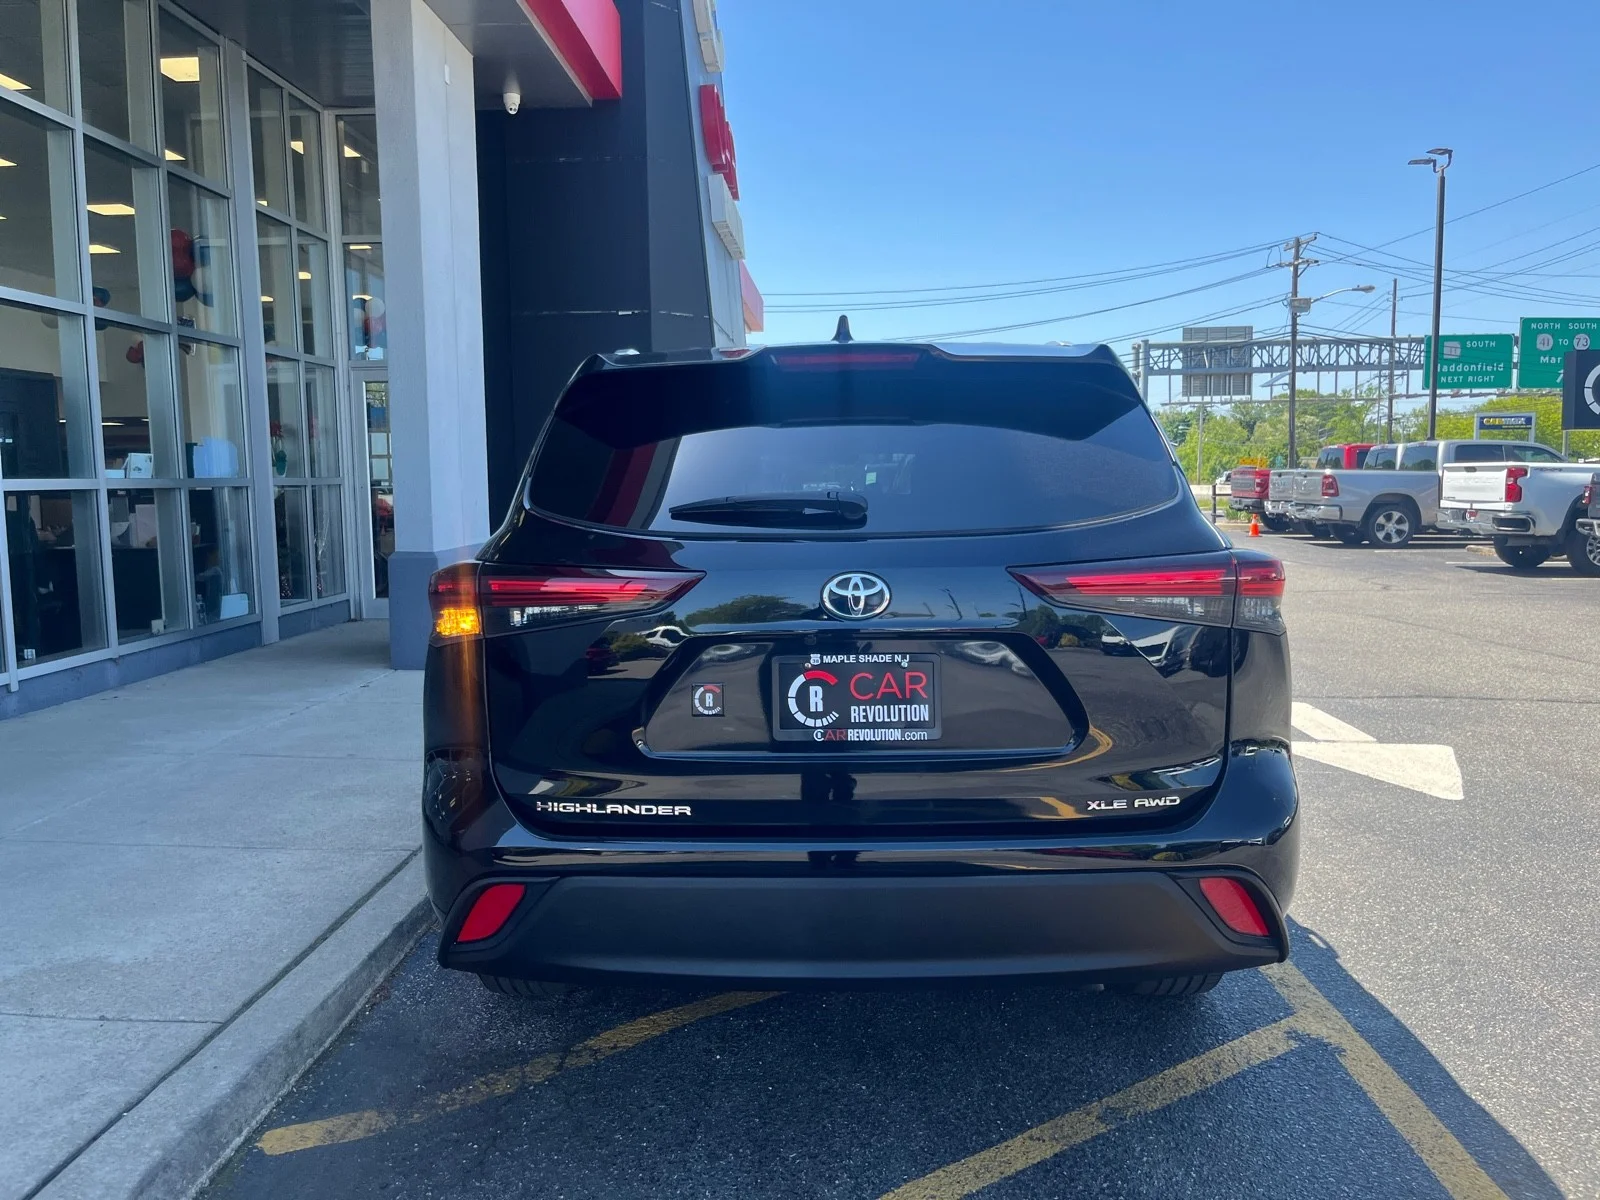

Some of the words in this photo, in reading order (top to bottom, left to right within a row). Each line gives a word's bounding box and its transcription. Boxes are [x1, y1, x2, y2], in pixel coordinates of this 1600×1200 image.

[1530, 322, 1561, 330] NORTH
[1568, 322, 1597, 330] SOUTH
[1466, 340, 1496, 349] SOUTH
[1558, 338, 1569, 346] TO
[1575, 337, 1589, 347] 73
[1540, 355, 1563, 364] Mar
[1440, 375, 1464, 384] NEXT
[1467, 375, 1495, 383] RIGHT
[823, 654, 857, 663] MAPLE
[858, 654, 892, 663] SHADE
[849, 671, 928, 700] CAR
[850, 704, 930, 723] REVOLUTION
[1087, 799, 1128, 811] XLE
[1134, 796, 1180, 808] AWD
[536, 801, 692, 816] HIGHLANDER
